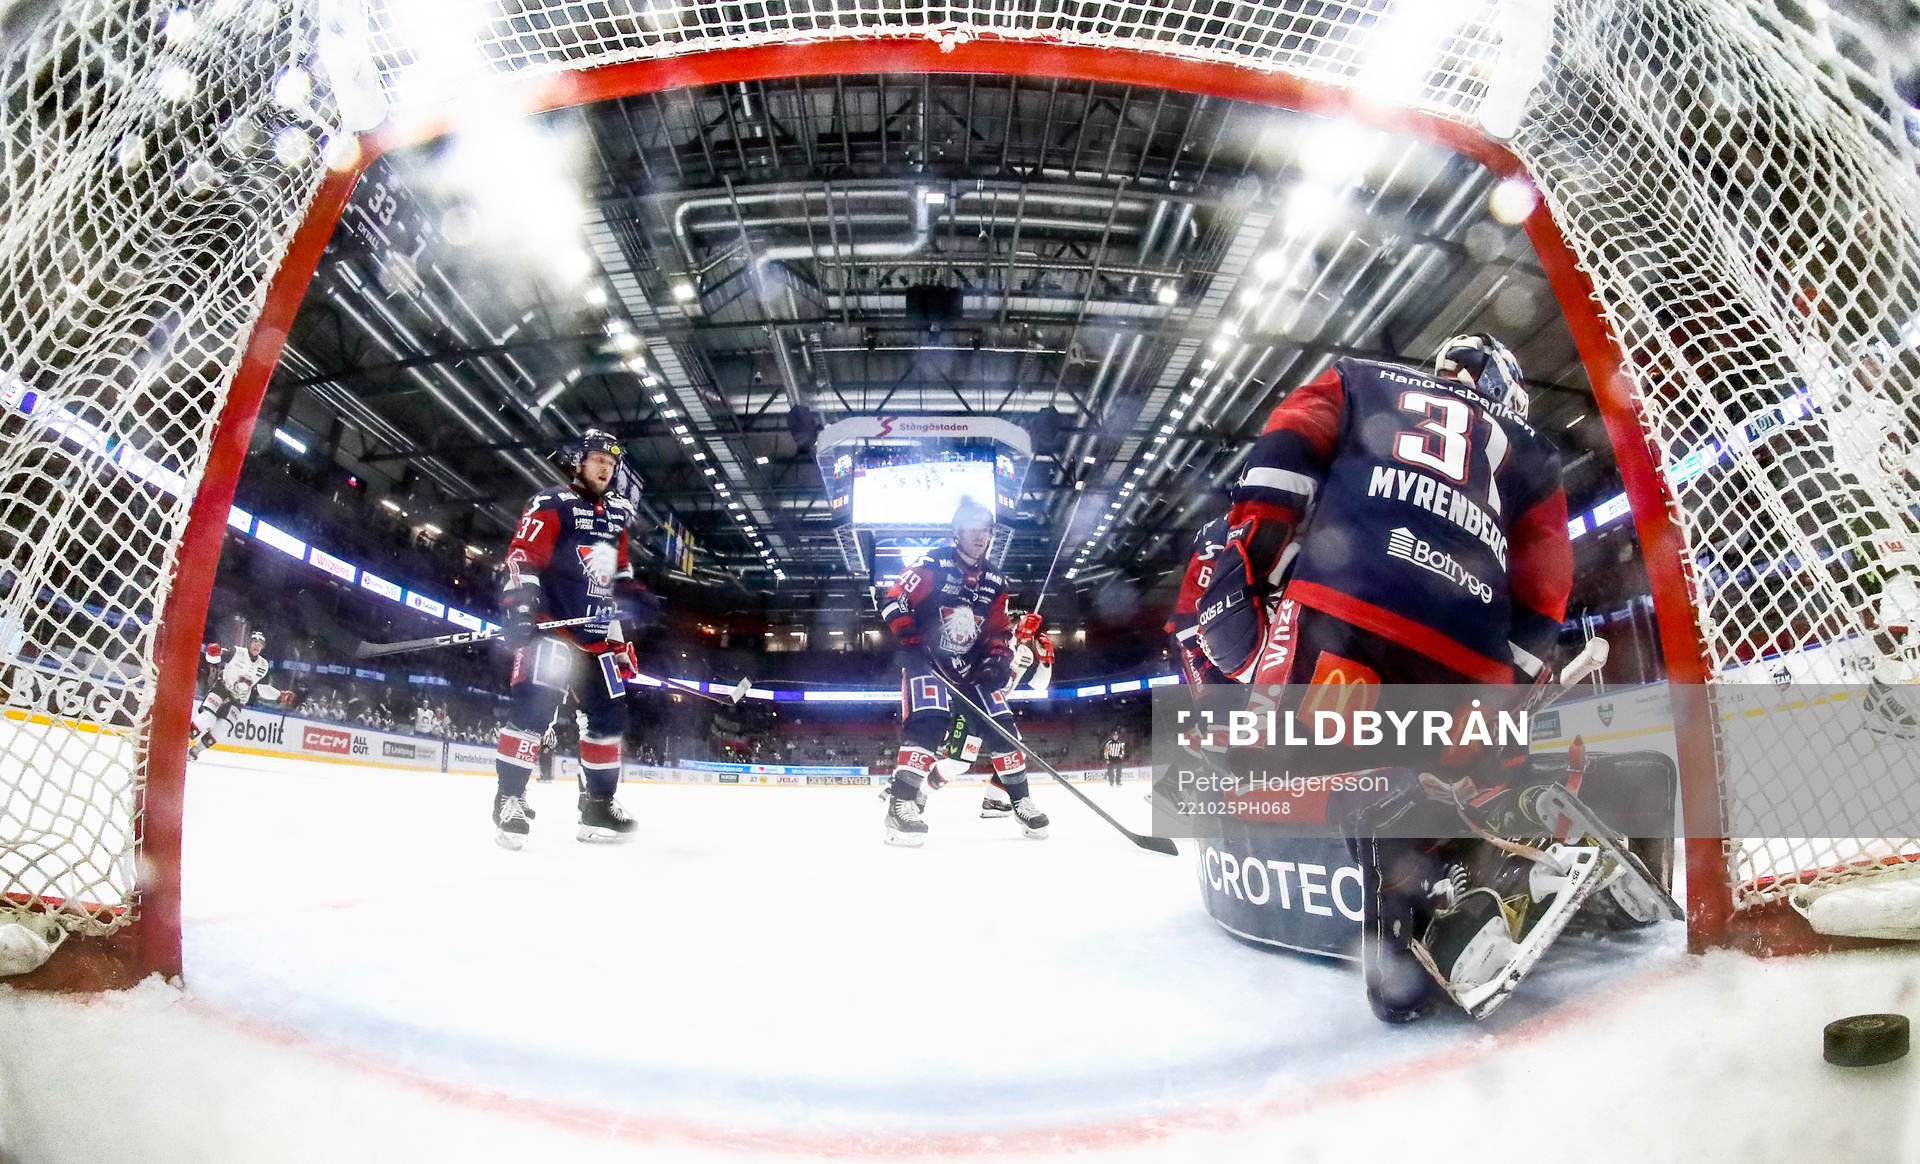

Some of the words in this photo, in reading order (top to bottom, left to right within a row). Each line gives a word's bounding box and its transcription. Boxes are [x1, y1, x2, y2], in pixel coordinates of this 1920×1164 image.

[368, 182, 397, 226] 33
[900, 422, 969, 432] Stångåstaden
[1368, 466, 1508, 574] MYRENBERG
[517, 518, 544, 542] 37
[899, 568, 922, 593] 49
[435, 630, 490, 645] CCM
[305, 733, 348, 749] CCM
[353, 735, 367, 746] ALL
[518, 739, 539, 754] BC
[909, 751, 929, 766] BC
[1003, 752, 1020, 766] BC
[1199, 846, 1364, 922] ICROTEC
